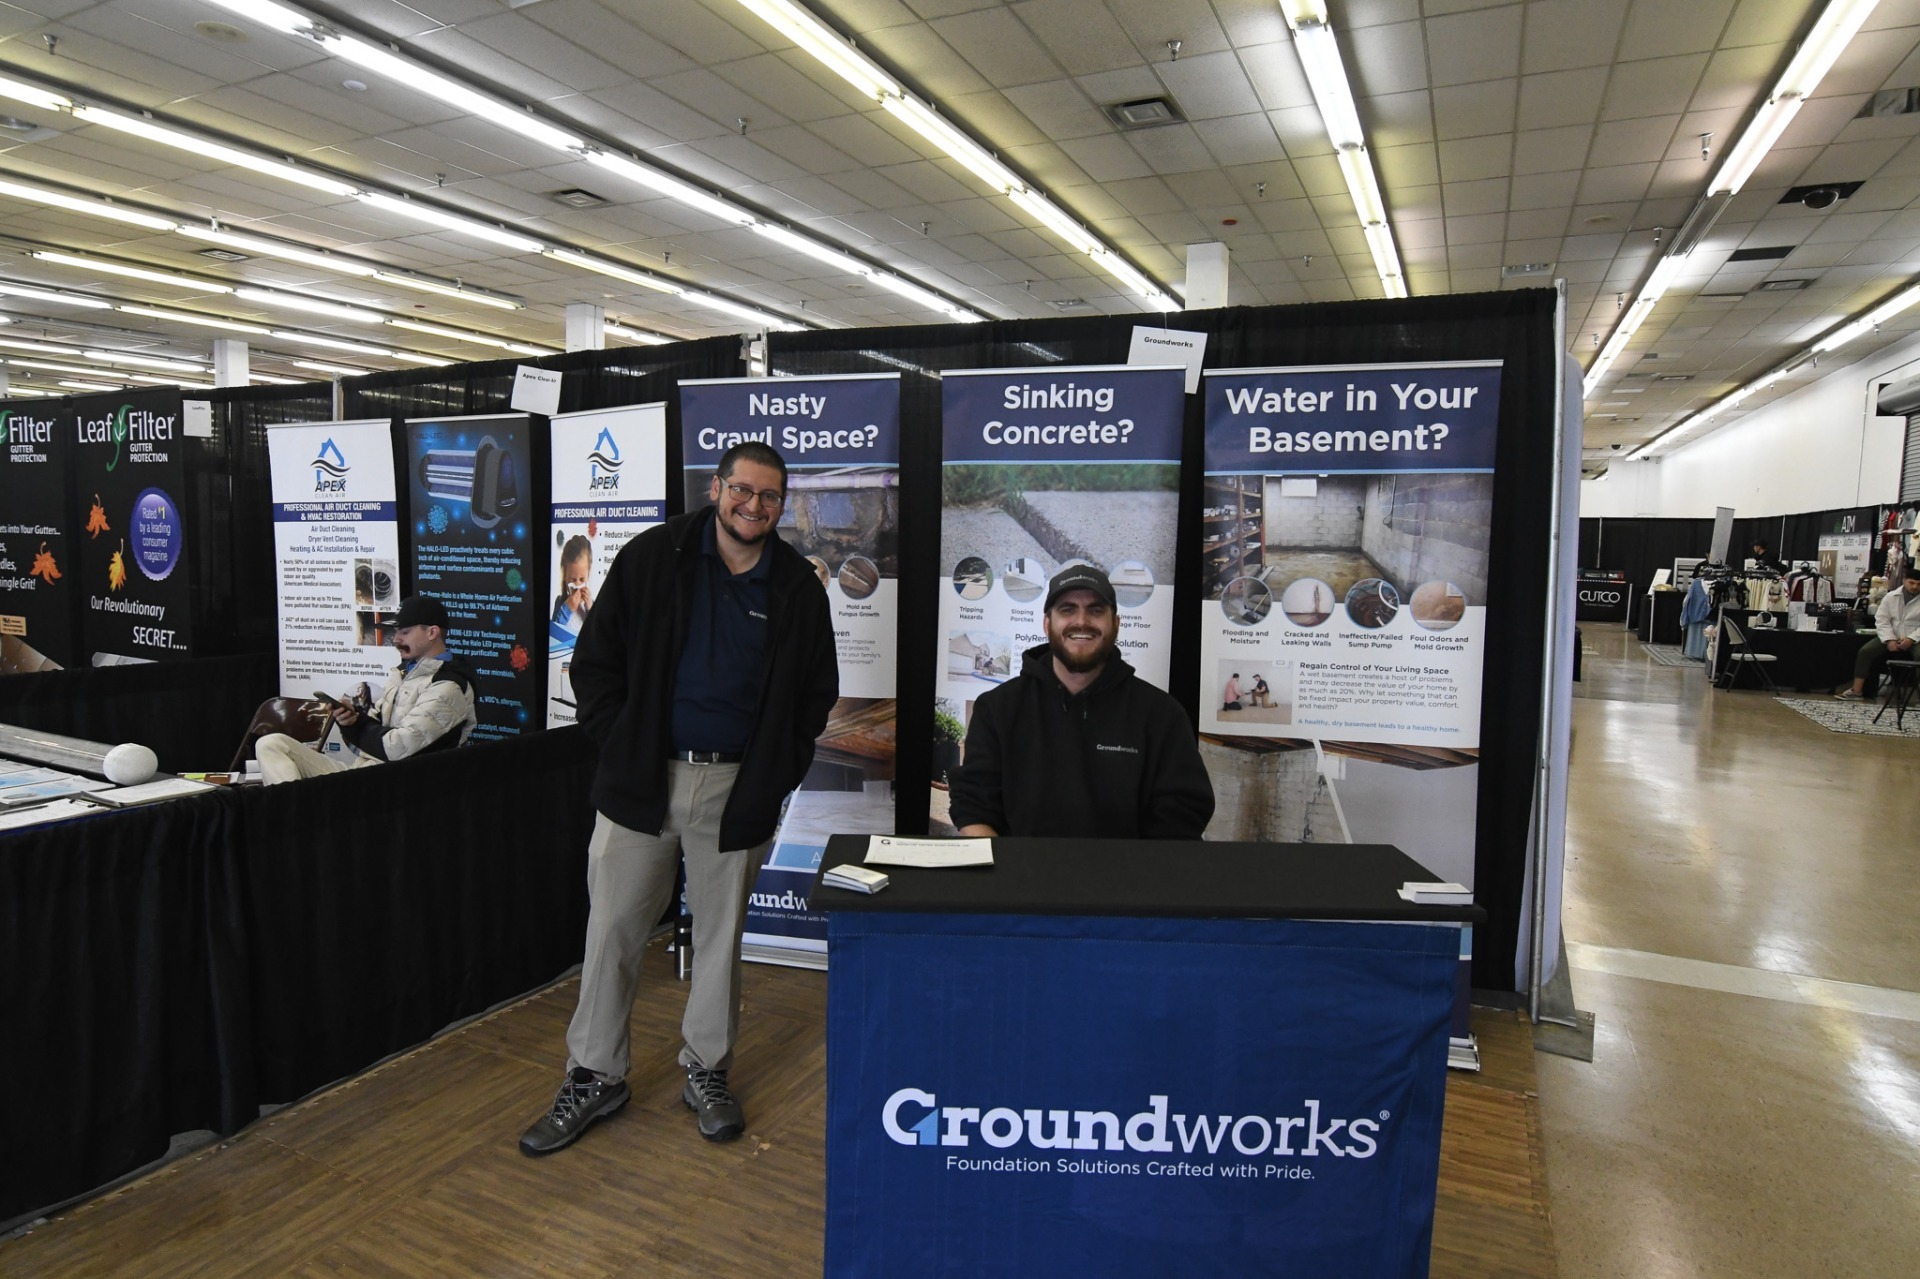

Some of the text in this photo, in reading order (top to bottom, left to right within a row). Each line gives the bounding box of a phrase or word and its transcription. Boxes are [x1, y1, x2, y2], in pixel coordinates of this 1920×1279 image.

[1144, 336, 1193, 348] Groundworks
[1004, 384, 1114, 412] Sinking
[1226, 383, 1478, 414] Water in Your
[750, 394, 826, 420] Nasty
[9, 416, 54, 443] Filter
[983, 419, 1134, 444] Concrete?
[698, 424, 878, 453] Crawl Space?
[1249, 423, 1448, 452] Basement?
[10, 445, 34, 454] GUTTER
[130, 443, 153, 452] GUTTER
[10, 454, 47, 462] PROTECTION
[130, 453, 168, 462] PROTECTION
[315, 480, 346, 492] APEX
[590, 476, 620, 490] APEX
[284, 502, 381, 512] PROFESSIONAL AIR DUCT CLEANING
[555, 506, 658, 518] PROFESSIONAL AIR DUCT CLEANING
[142, 507, 157, 520] Rated
[323, 512, 362, 520] RESTORATION
[8, 525, 18, 534] into
[20, 524, 34, 534] Your
[140, 523, 146, 533] by
[151, 523, 170, 536] leading
[332, 525, 355, 533] Cleaning
[142, 538, 168, 548] consumer
[143, 551, 168, 563] magazine
[20, 578, 36, 590] Grit!
[1580, 590, 1620, 604] CUTCO
[91, 596, 165, 620] Our Revolutionary
[1016, 634, 1048, 642] PolyRen
[1339, 632, 1402, 640] Ineffective/Failed
[1114, 640, 1148, 648] Solution
[1300, 662, 1328, 671] Regain
[1396, 666, 1420, 674] Living
[1424, 667, 1449, 675] Space
[1388, 691, 1424, 699] something
[1096, 744, 1138, 754] Groundworks
[948, 1156, 1314, 1180] Foundation Solutions Crafted with Pride.
